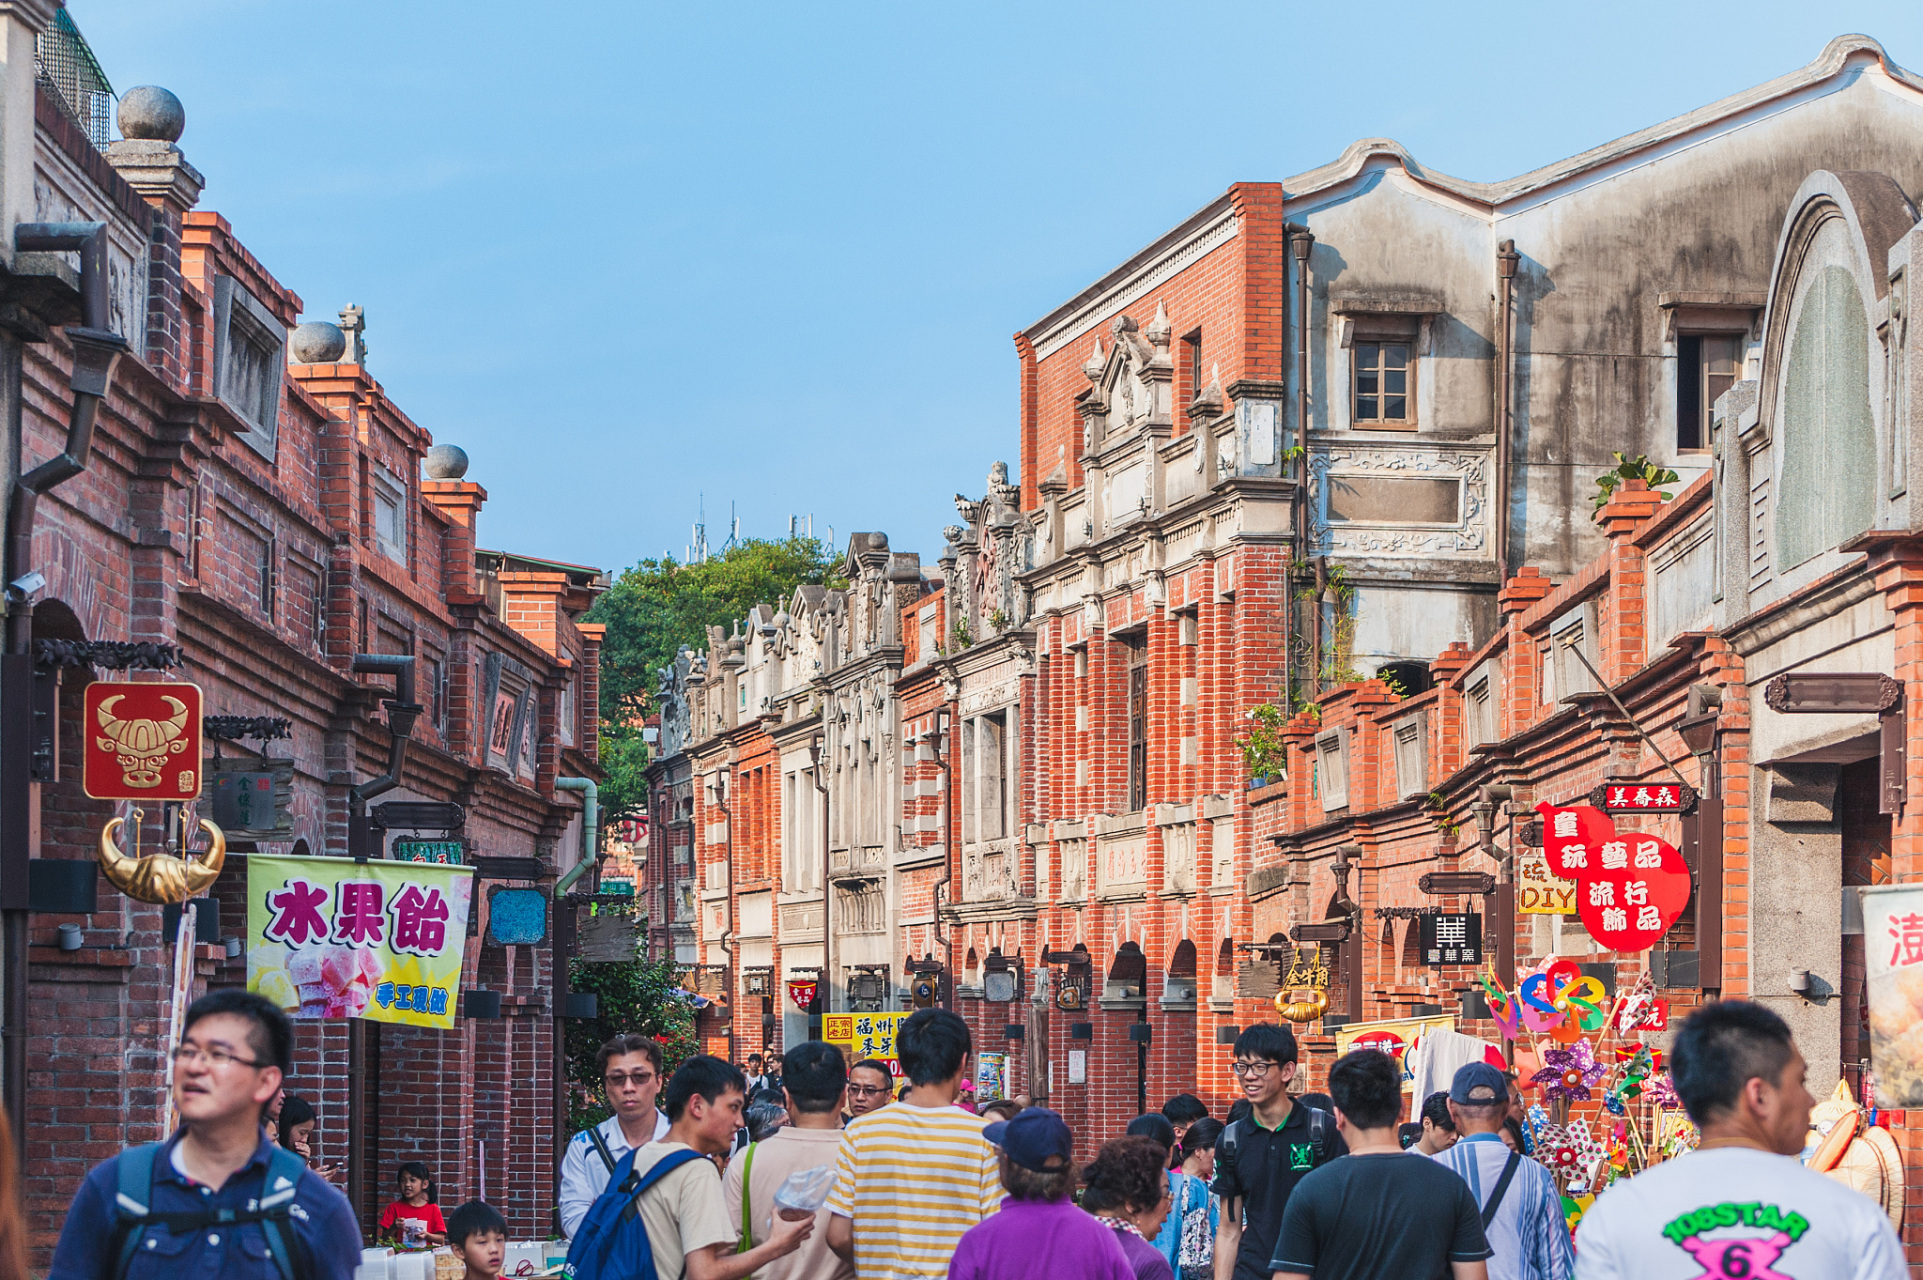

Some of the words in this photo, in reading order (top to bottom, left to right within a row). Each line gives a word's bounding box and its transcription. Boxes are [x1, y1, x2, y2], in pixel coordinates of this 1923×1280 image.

[1609, 787, 1678, 807] 美喬森
[1521, 887, 1575, 908] DIY
[1589, 881, 1648, 906] 流行
[272, 881, 449, 952] 水果飴
[1601, 906, 1661, 932] 飾品
[1287, 966, 1329, 986] 金牛角
[376, 982, 449, 1015] 手工現做
[829, 1020, 850, 1028] 正宗
[829, 1028, 850, 1037] 老店
[1661, 1201, 1810, 1246] 108STAR
[1721, 1243, 1752, 1279] 6
